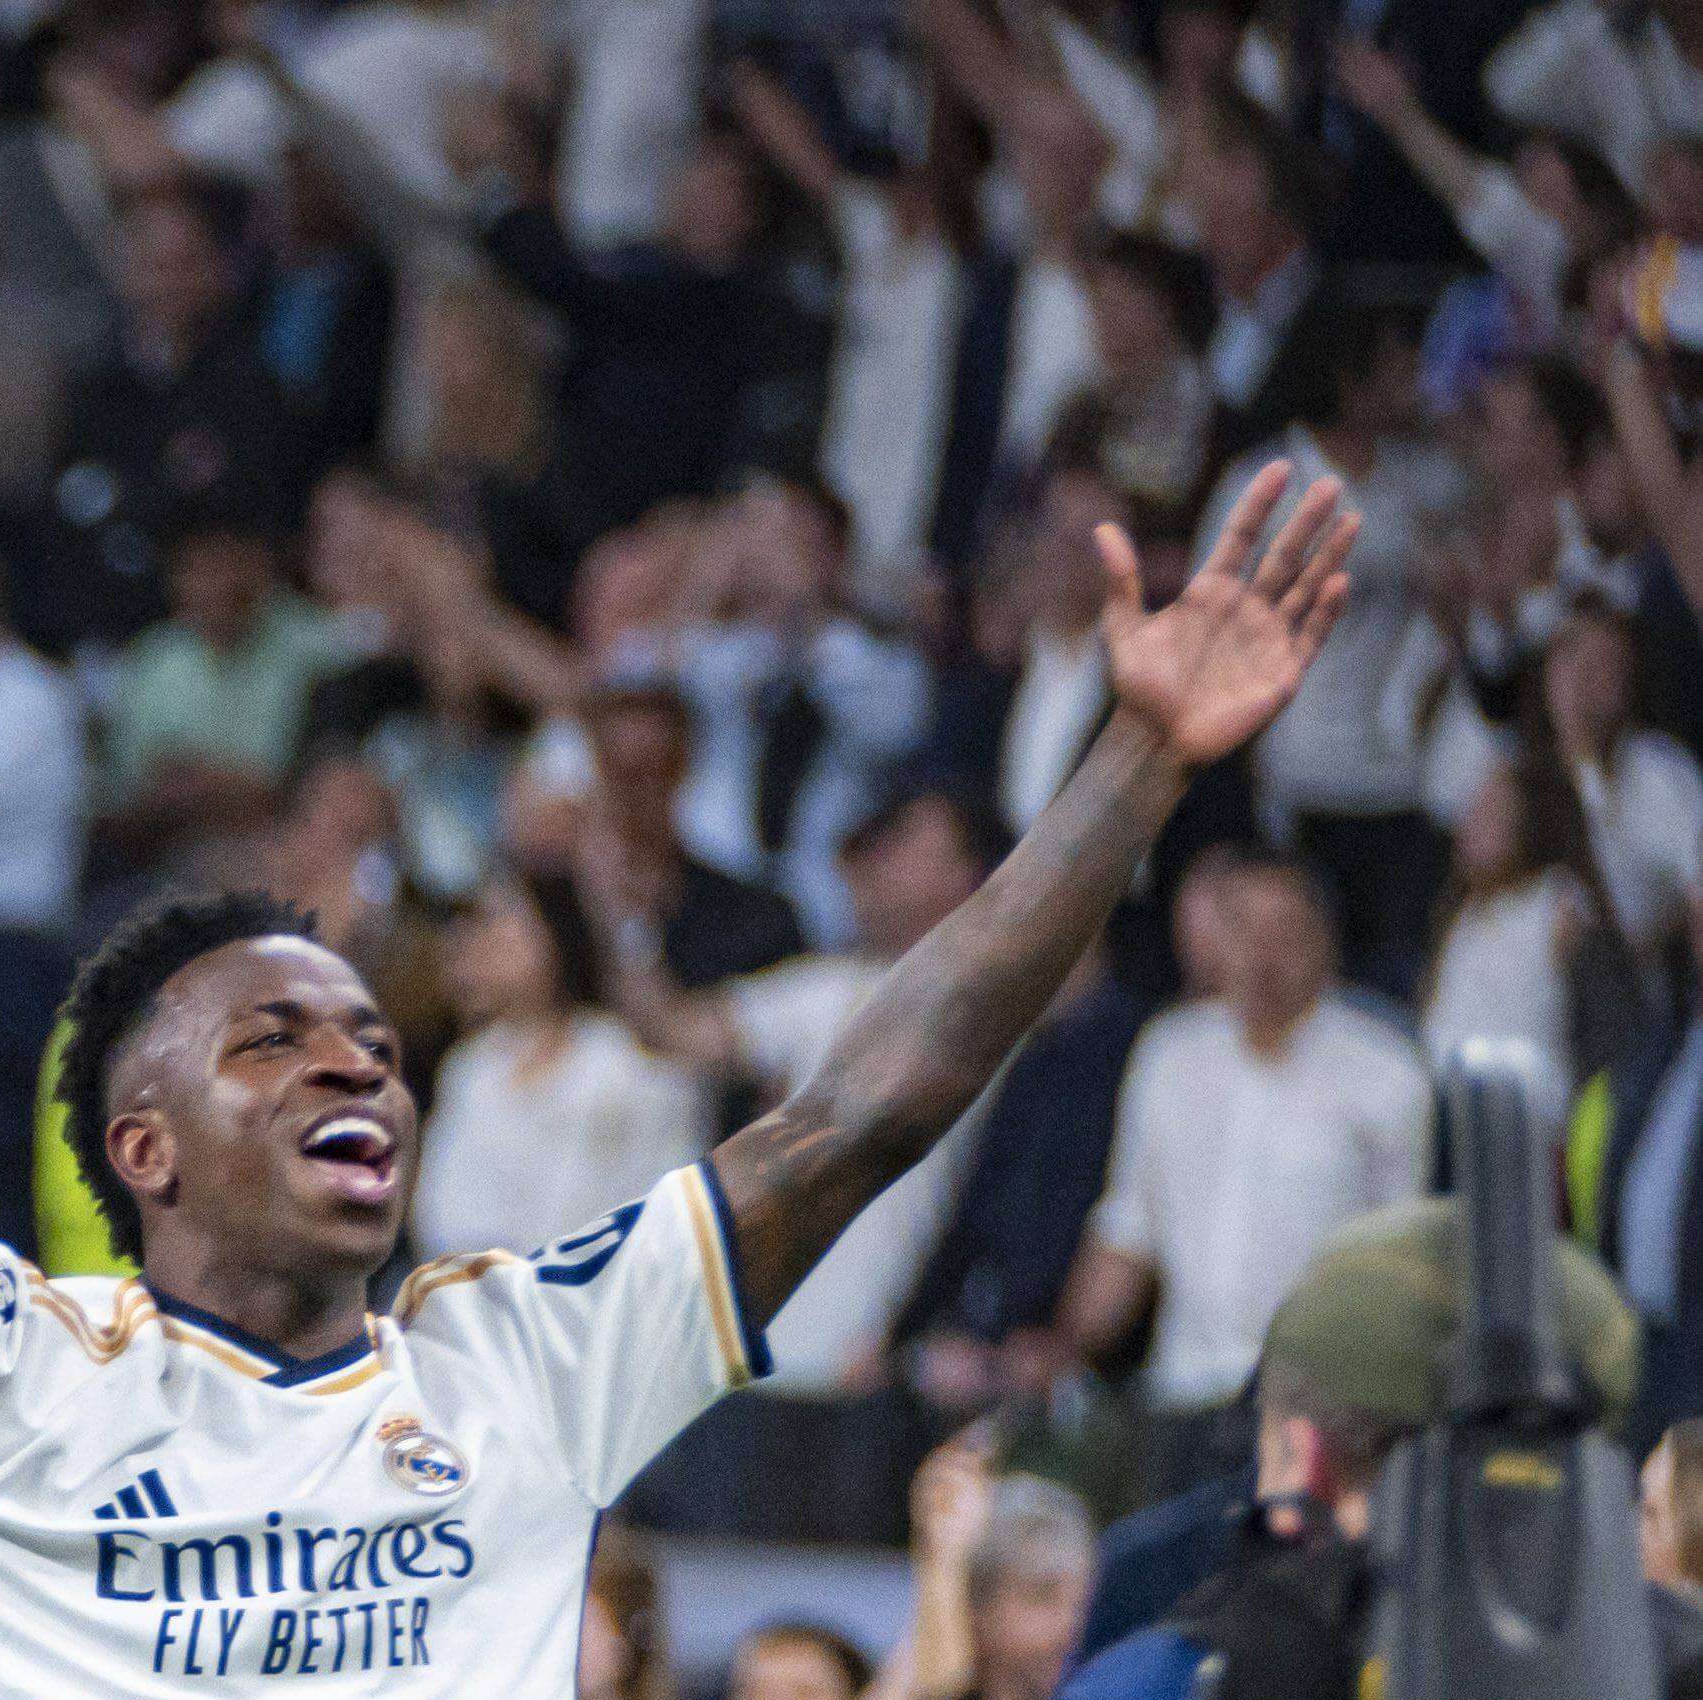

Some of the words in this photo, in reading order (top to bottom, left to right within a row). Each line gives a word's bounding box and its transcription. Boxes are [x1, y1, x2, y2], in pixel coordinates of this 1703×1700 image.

[94, 1511, 475, 1602] Emirates
[152, 1608, 245, 1676] FLY
[260, 1597, 430, 1676] BETTER
